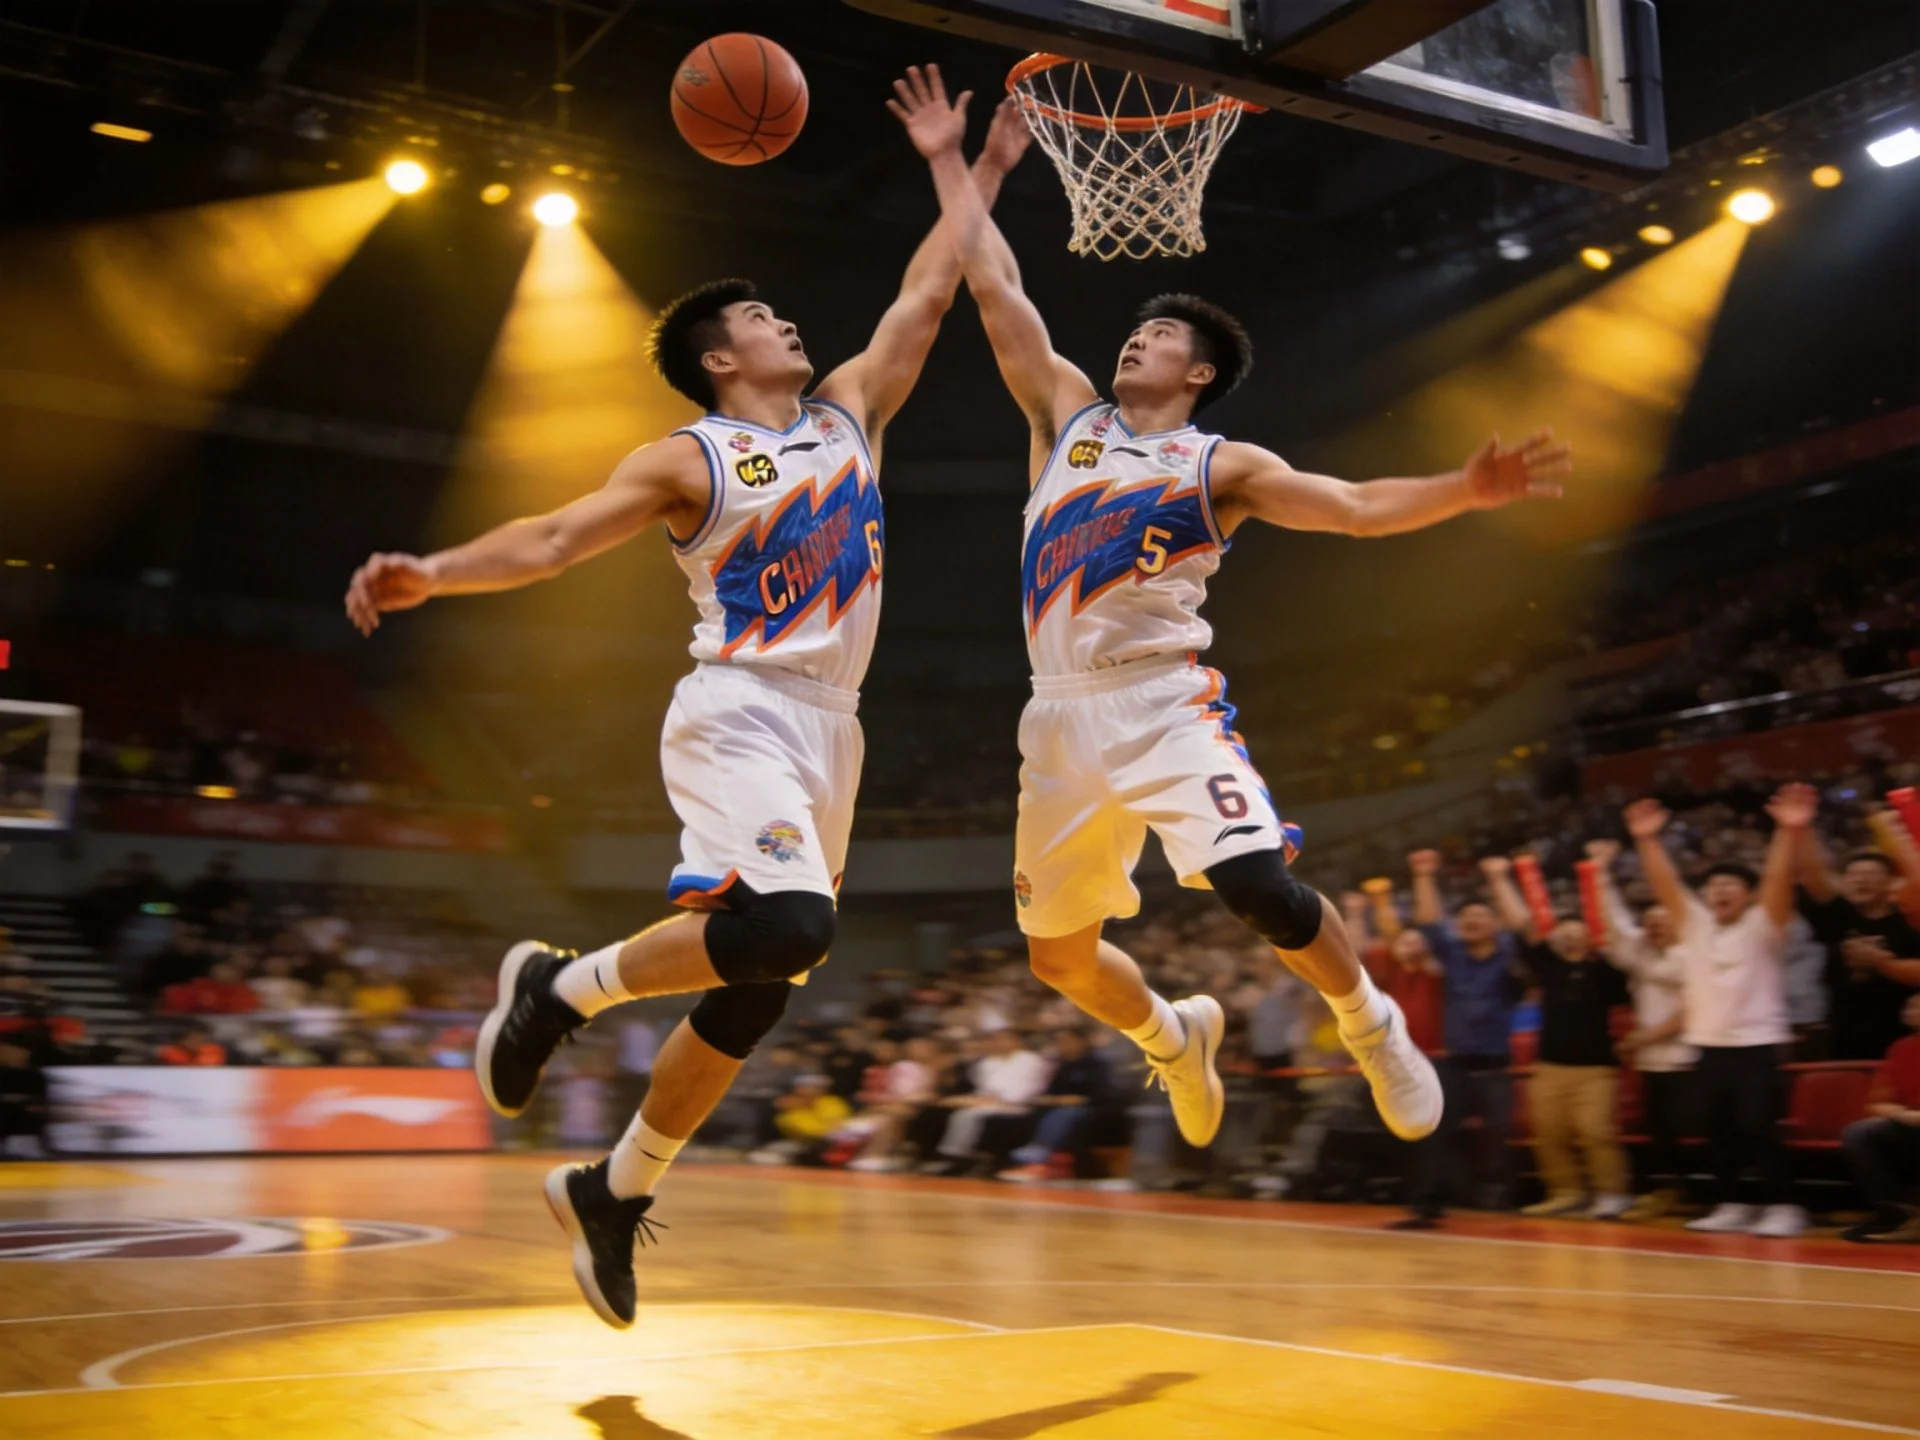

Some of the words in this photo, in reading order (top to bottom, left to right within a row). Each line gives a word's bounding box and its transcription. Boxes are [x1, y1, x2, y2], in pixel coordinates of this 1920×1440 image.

[864, 519, 883, 576] 6
[1135, 524, 1173, 575] 5
[1205, 772, 1249, 820] 6
